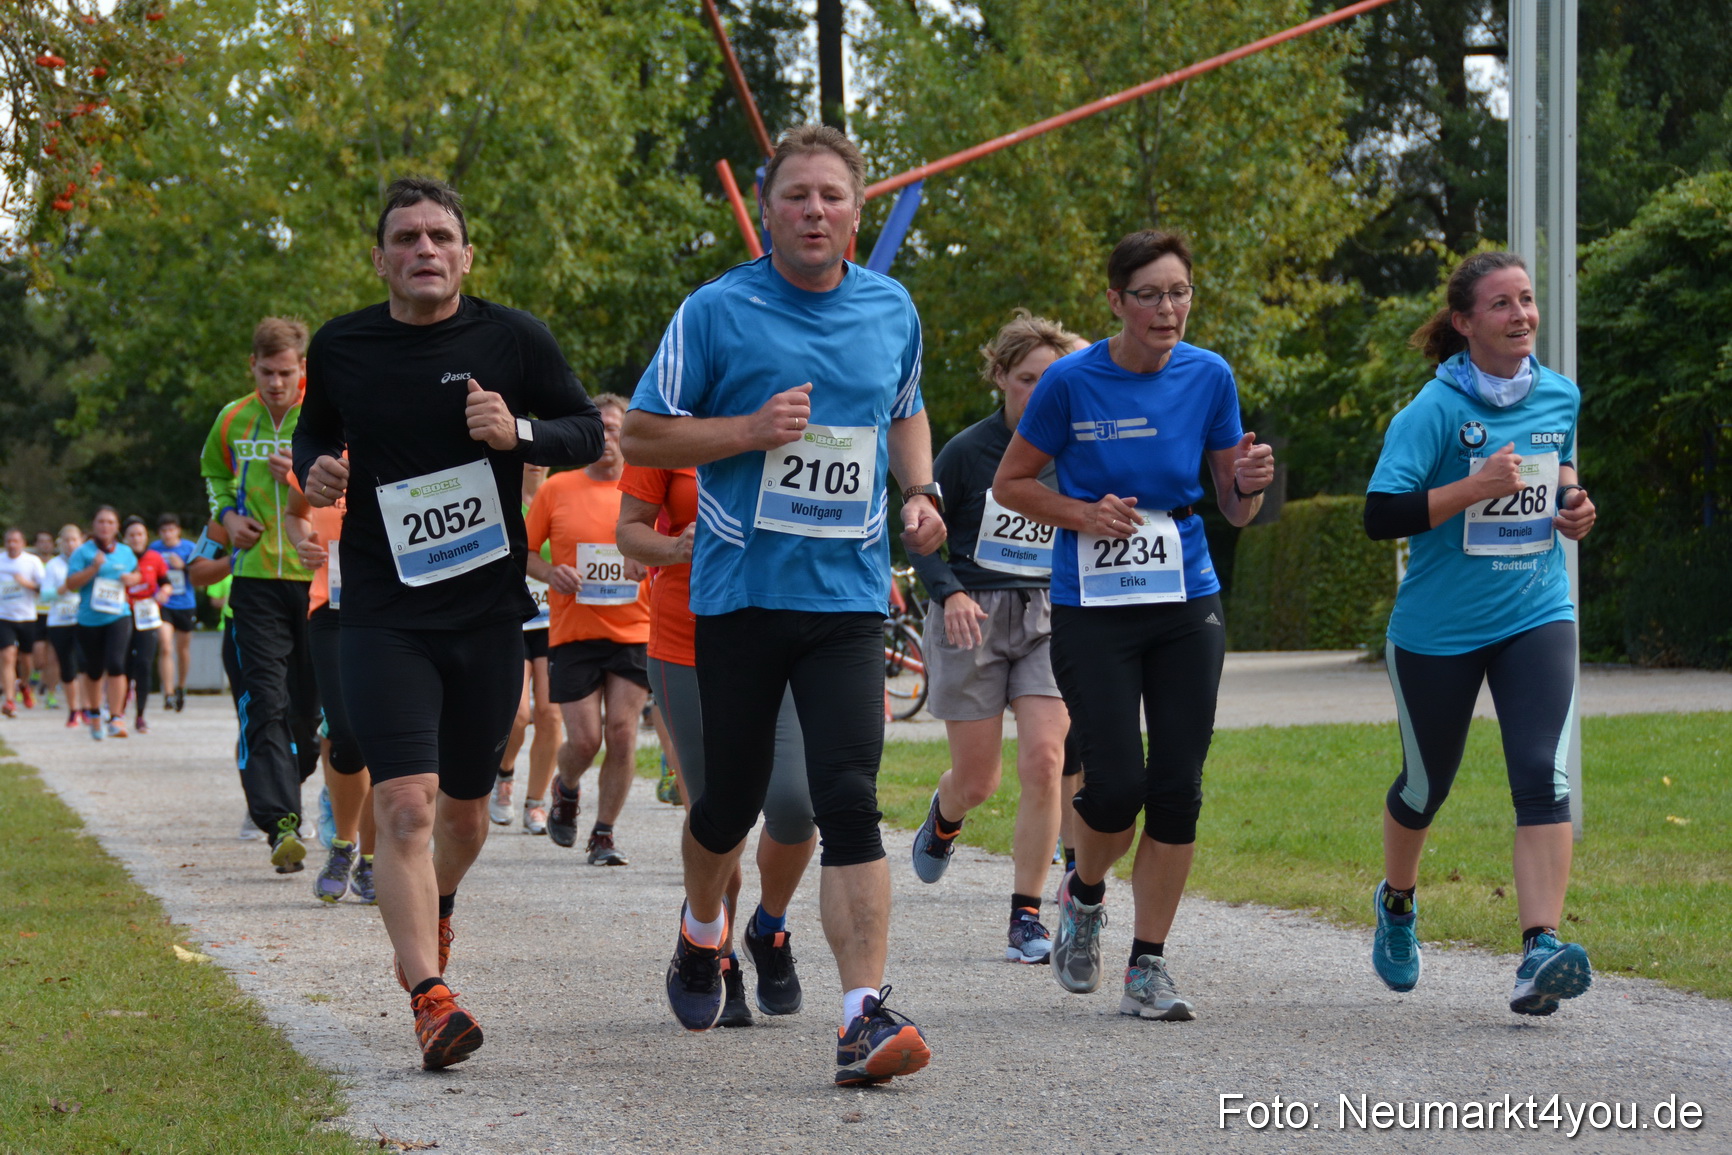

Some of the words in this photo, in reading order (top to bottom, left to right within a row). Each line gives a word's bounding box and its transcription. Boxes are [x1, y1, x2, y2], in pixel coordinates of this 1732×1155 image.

[451, 372, 471, 381] asics
[816, 434, 852, 447] BOCK
[1531, 432, 1566, 445] BOCK
[234, 440, 292, 460] BO
[780, 455, 861, 494] 2103
[421, 478, 461, 495] BOCK
[1482, 484, 1547, 516] 2268
[791, 502, 843, 520] Wolfgang
[402, 497, 486, 546] 2052
[993, 514, 1054, 544] 2239
[1498, 526, 1532, 537] Daniela
[427, 540, 480, 565] Johannes
[1001, 547, 1038, 561] Christine
[1093, 535, 1167, 568] 2234
[586, 562, 628, 581] 209
[1492, 559, 1538, 570] Stadtlauf
[1120, 576, 1146, 588] Erika
